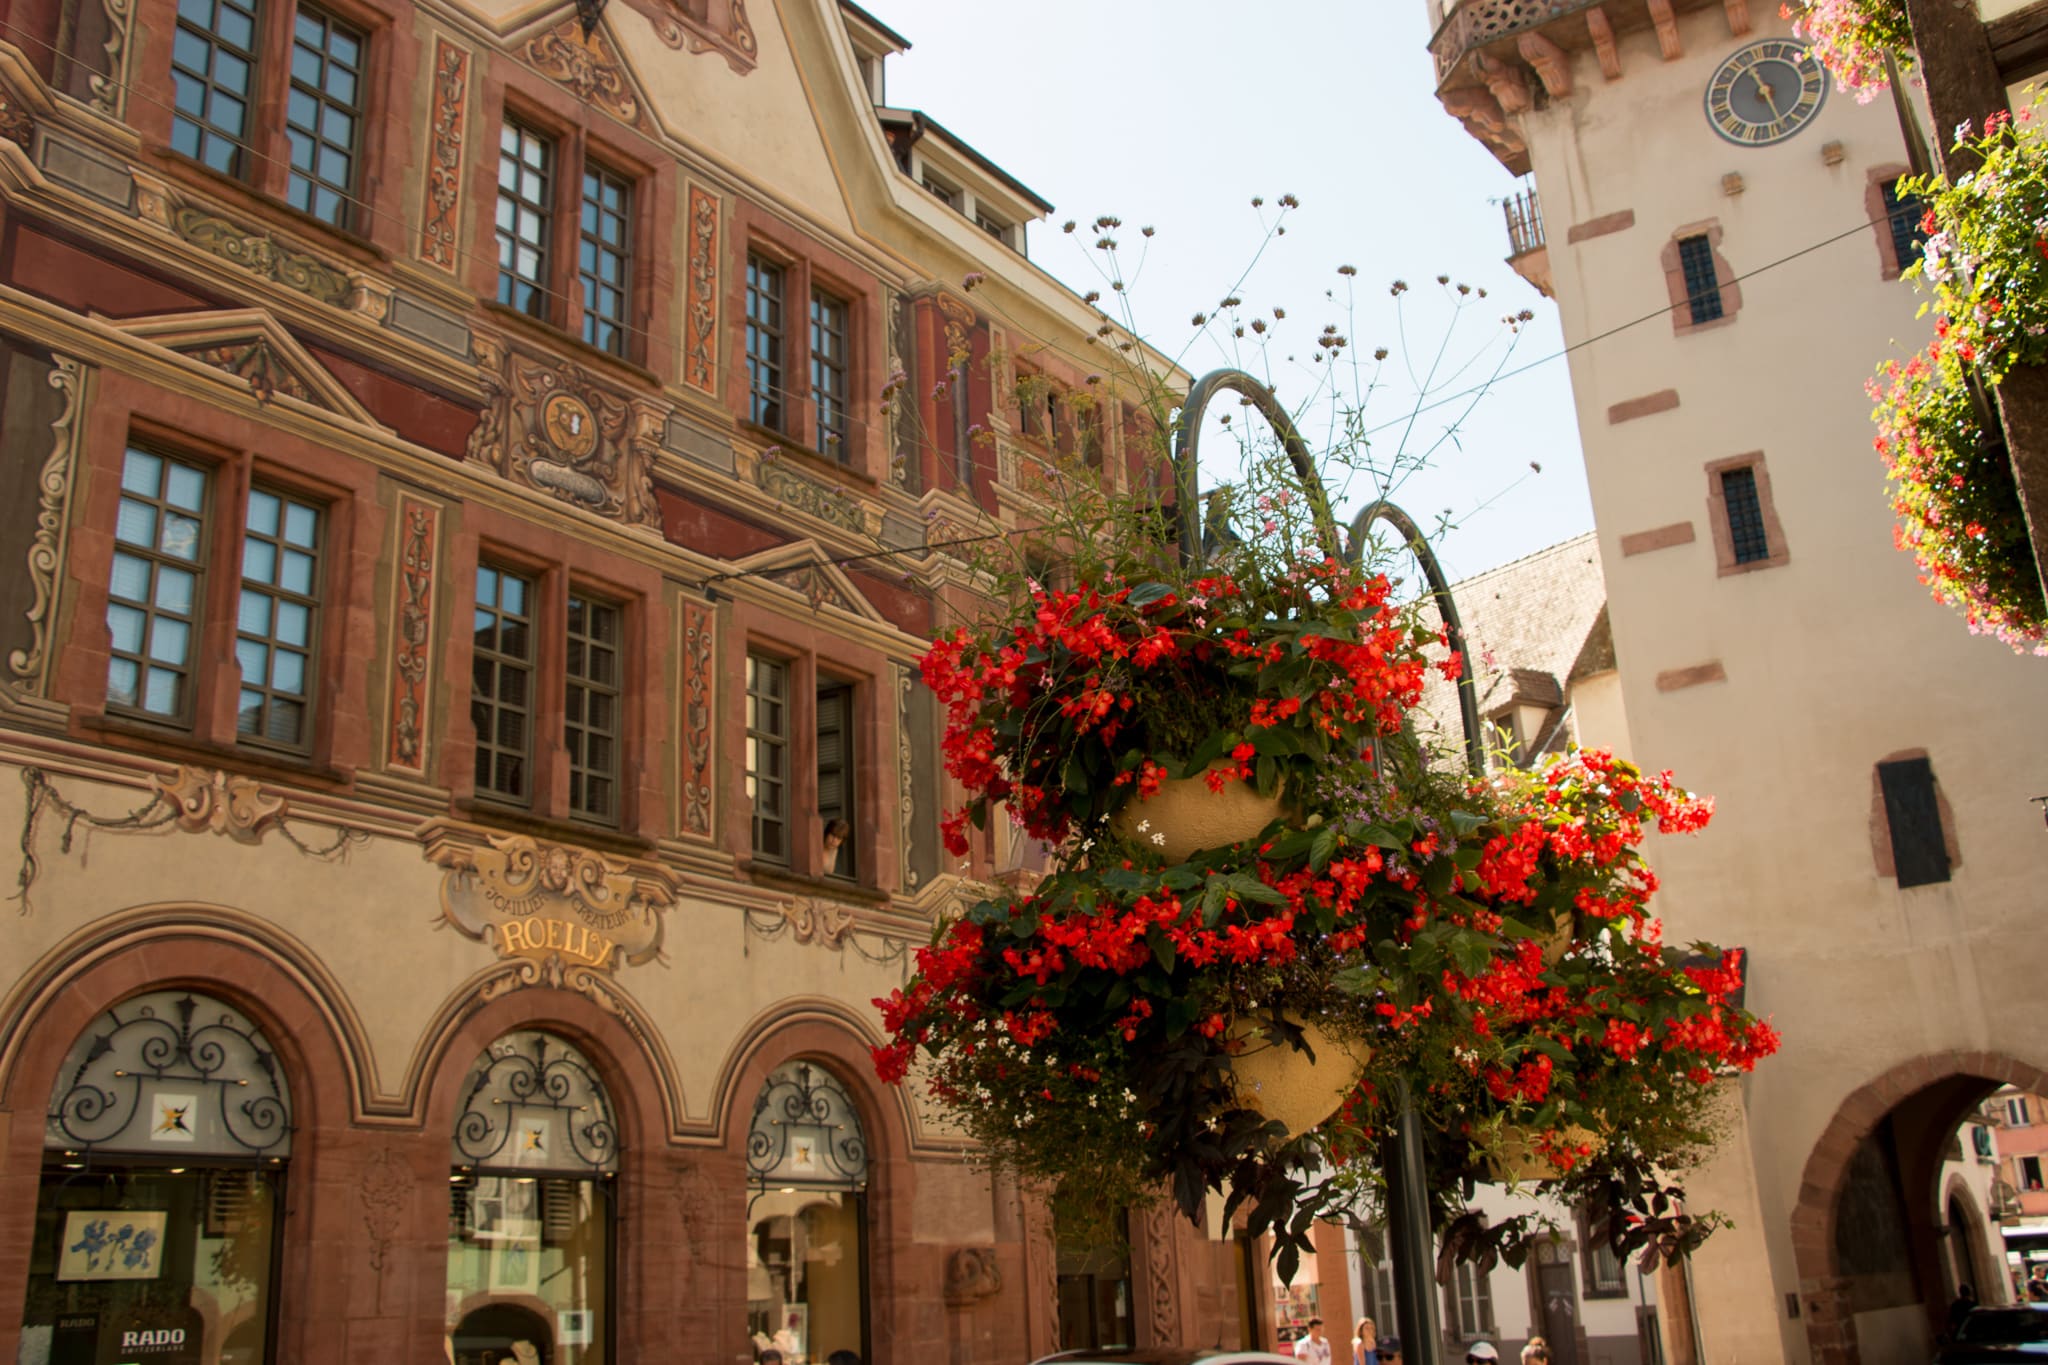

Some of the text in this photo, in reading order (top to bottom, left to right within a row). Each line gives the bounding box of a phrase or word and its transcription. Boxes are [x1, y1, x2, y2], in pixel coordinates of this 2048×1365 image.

[501, 916, 614, 966] ROELLY
[60, 1318, 96, 1329] RADO
[122, 1328, 185, 1347] RADO
[121, 1345, 184, 1354] SWITZERLAND
